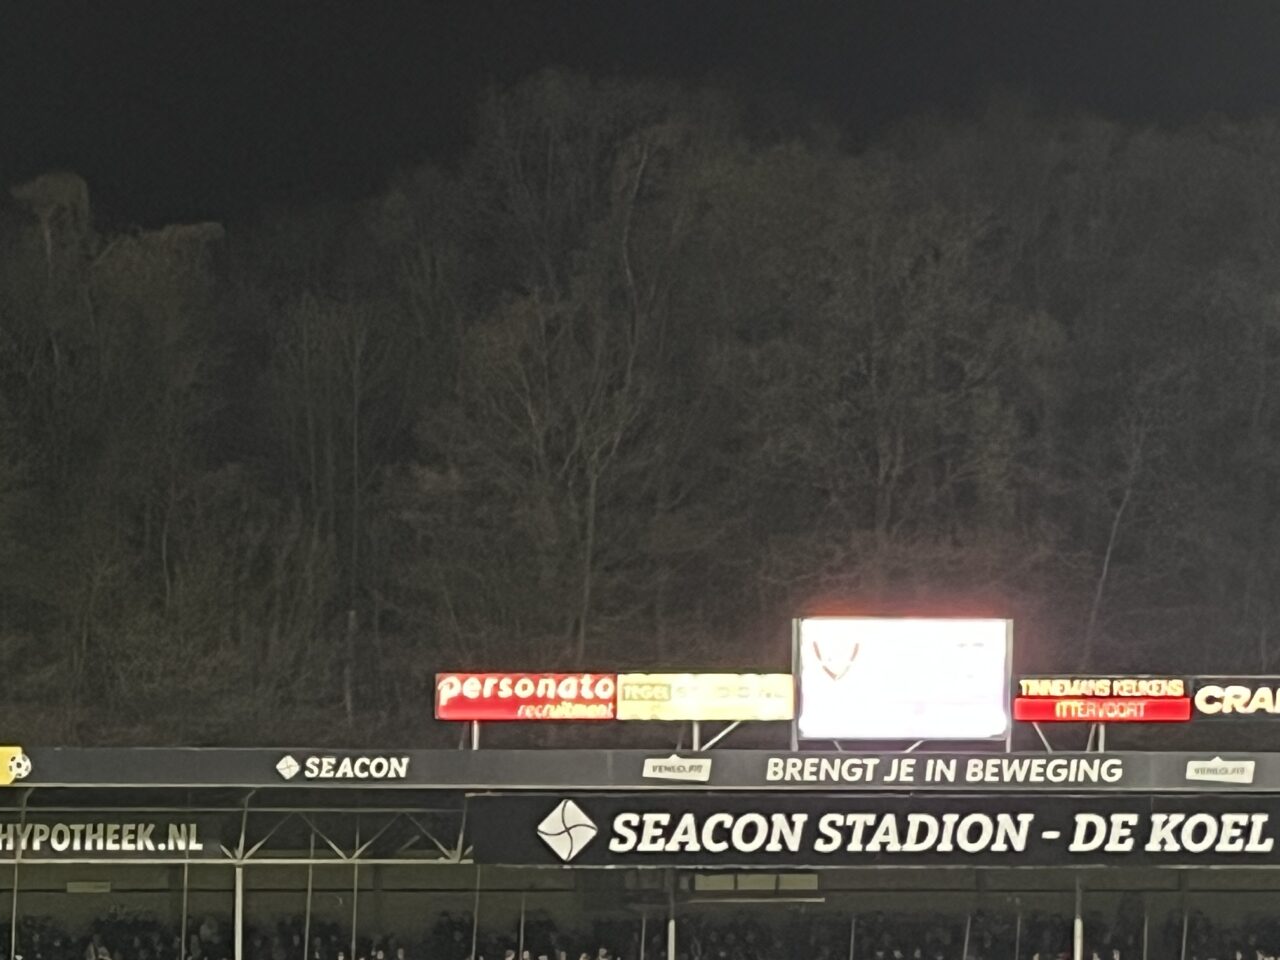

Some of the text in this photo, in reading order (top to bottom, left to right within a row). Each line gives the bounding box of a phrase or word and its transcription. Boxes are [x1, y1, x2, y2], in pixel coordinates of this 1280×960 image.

[438, 674, 615, 706] personato
[304, 757, 410, 778] SEACON
[766, 757, 1123, 783] BRENGT JE IN BEWEGING
[608, 812, 808, 853] SEACON
[813, 812, 1035, 853] STADION
[1069, 812, 1140, 853] DE
[1144, 812, 1274, 853] KOEL
